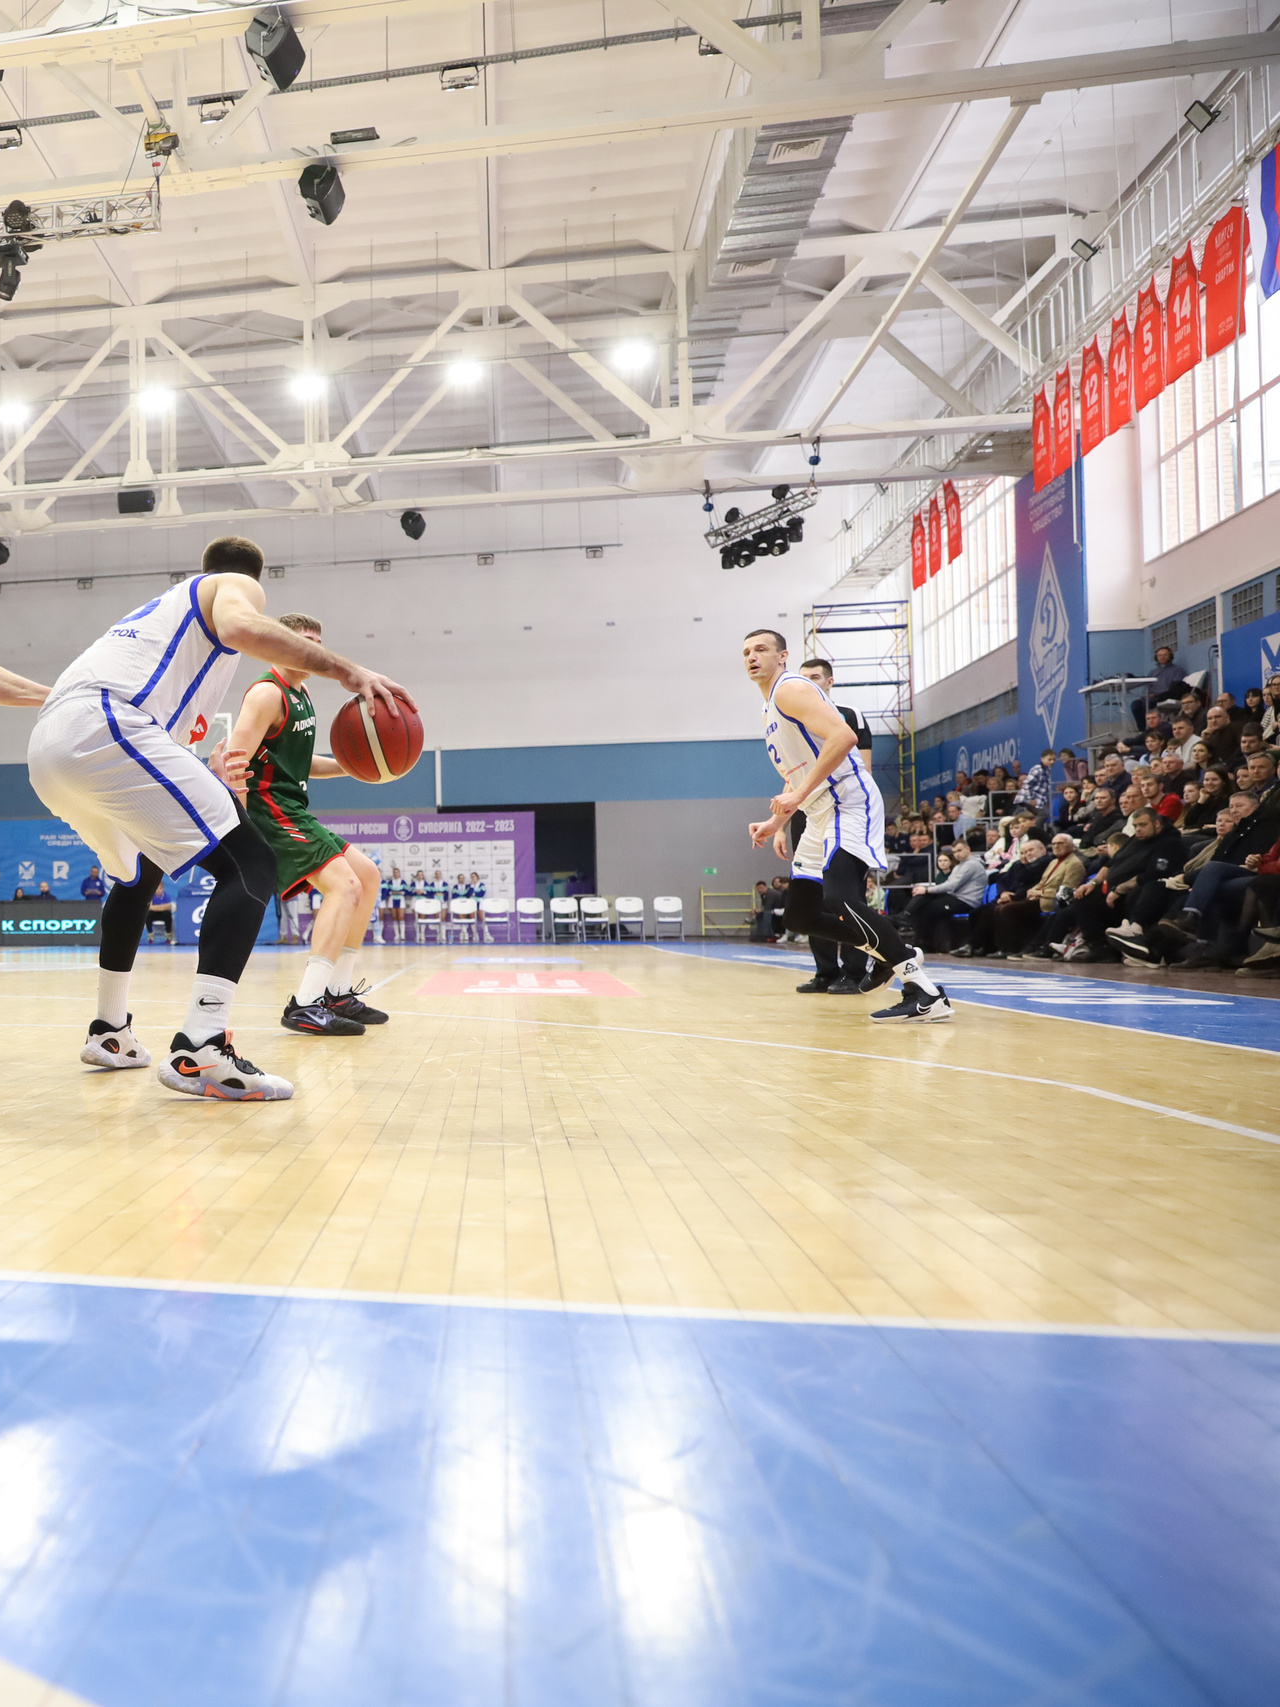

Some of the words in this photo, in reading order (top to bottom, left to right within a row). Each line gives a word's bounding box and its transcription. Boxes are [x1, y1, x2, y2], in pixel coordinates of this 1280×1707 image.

[1173, 285, 1191, 328] 14
[1143, 321, 1153, 355] 5
[1113, 346, 1127, 383] 14
[1084, 373, 1098, 408] 12
[1057, 399, 1069, 431] 15
[1037, 420, 1044, 446] 4
[972, 738, 1016, 777] ДИНАМО
[1, 919, 14, 931] К
[18, 919, 97, 931] СПОРТУ
